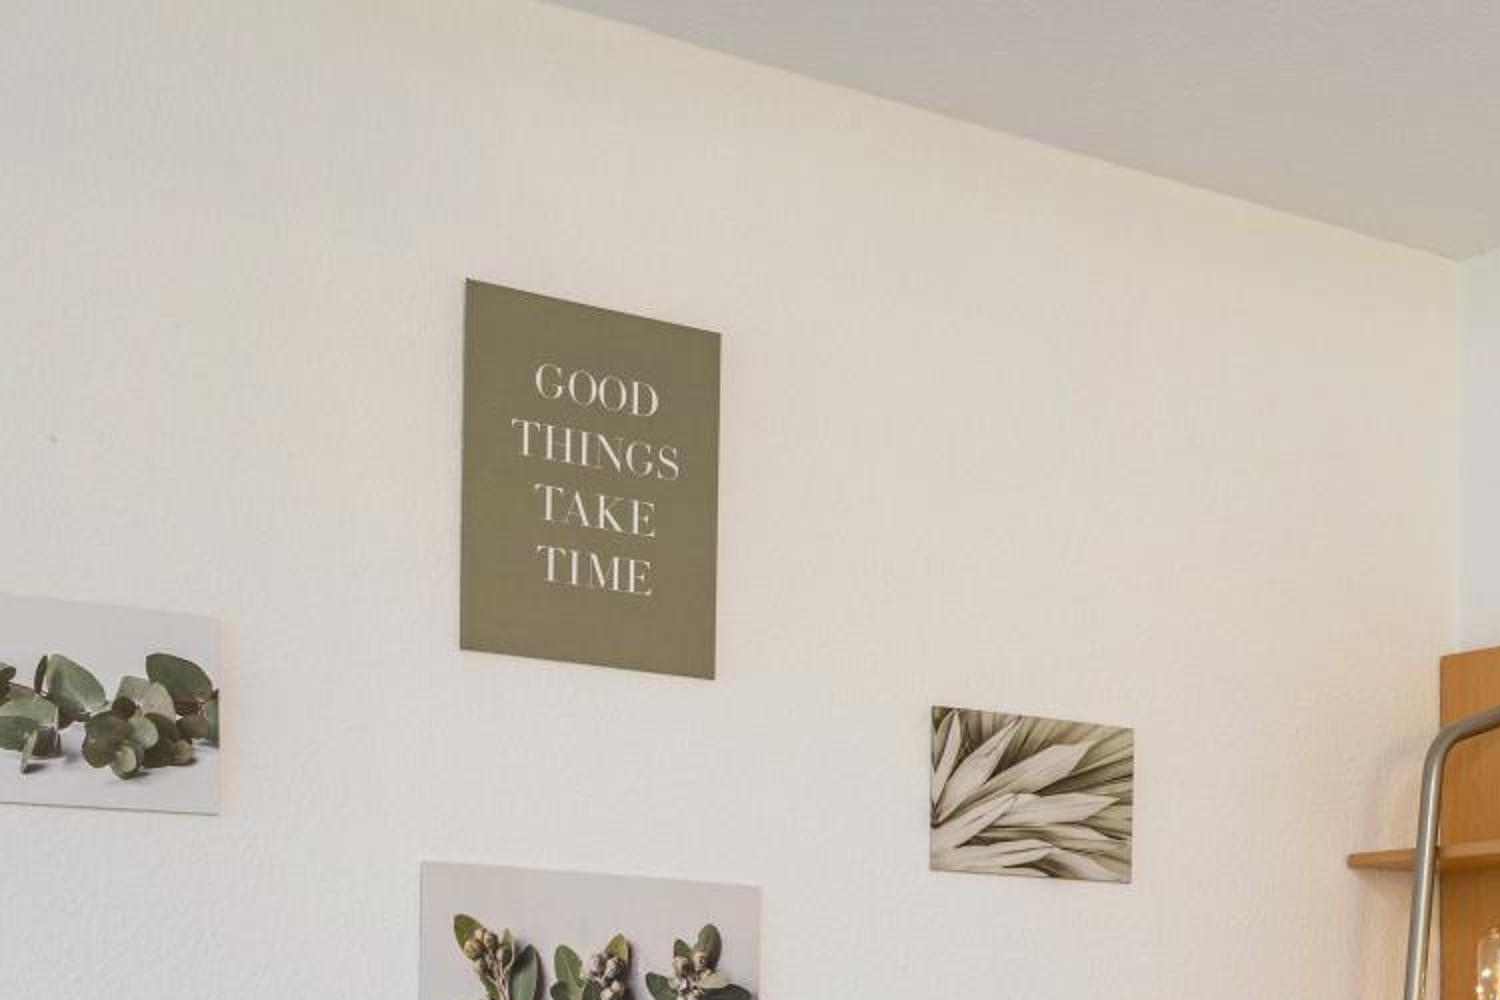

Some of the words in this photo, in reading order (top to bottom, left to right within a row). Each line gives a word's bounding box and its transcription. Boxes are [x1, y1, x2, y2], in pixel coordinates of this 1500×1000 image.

[535, 363, 660, 417] GOOD
[511, 418, 680, 480] THINGS
[534, 483, 655, 537] TAKE
[536, 545, 653, 596] TIME
